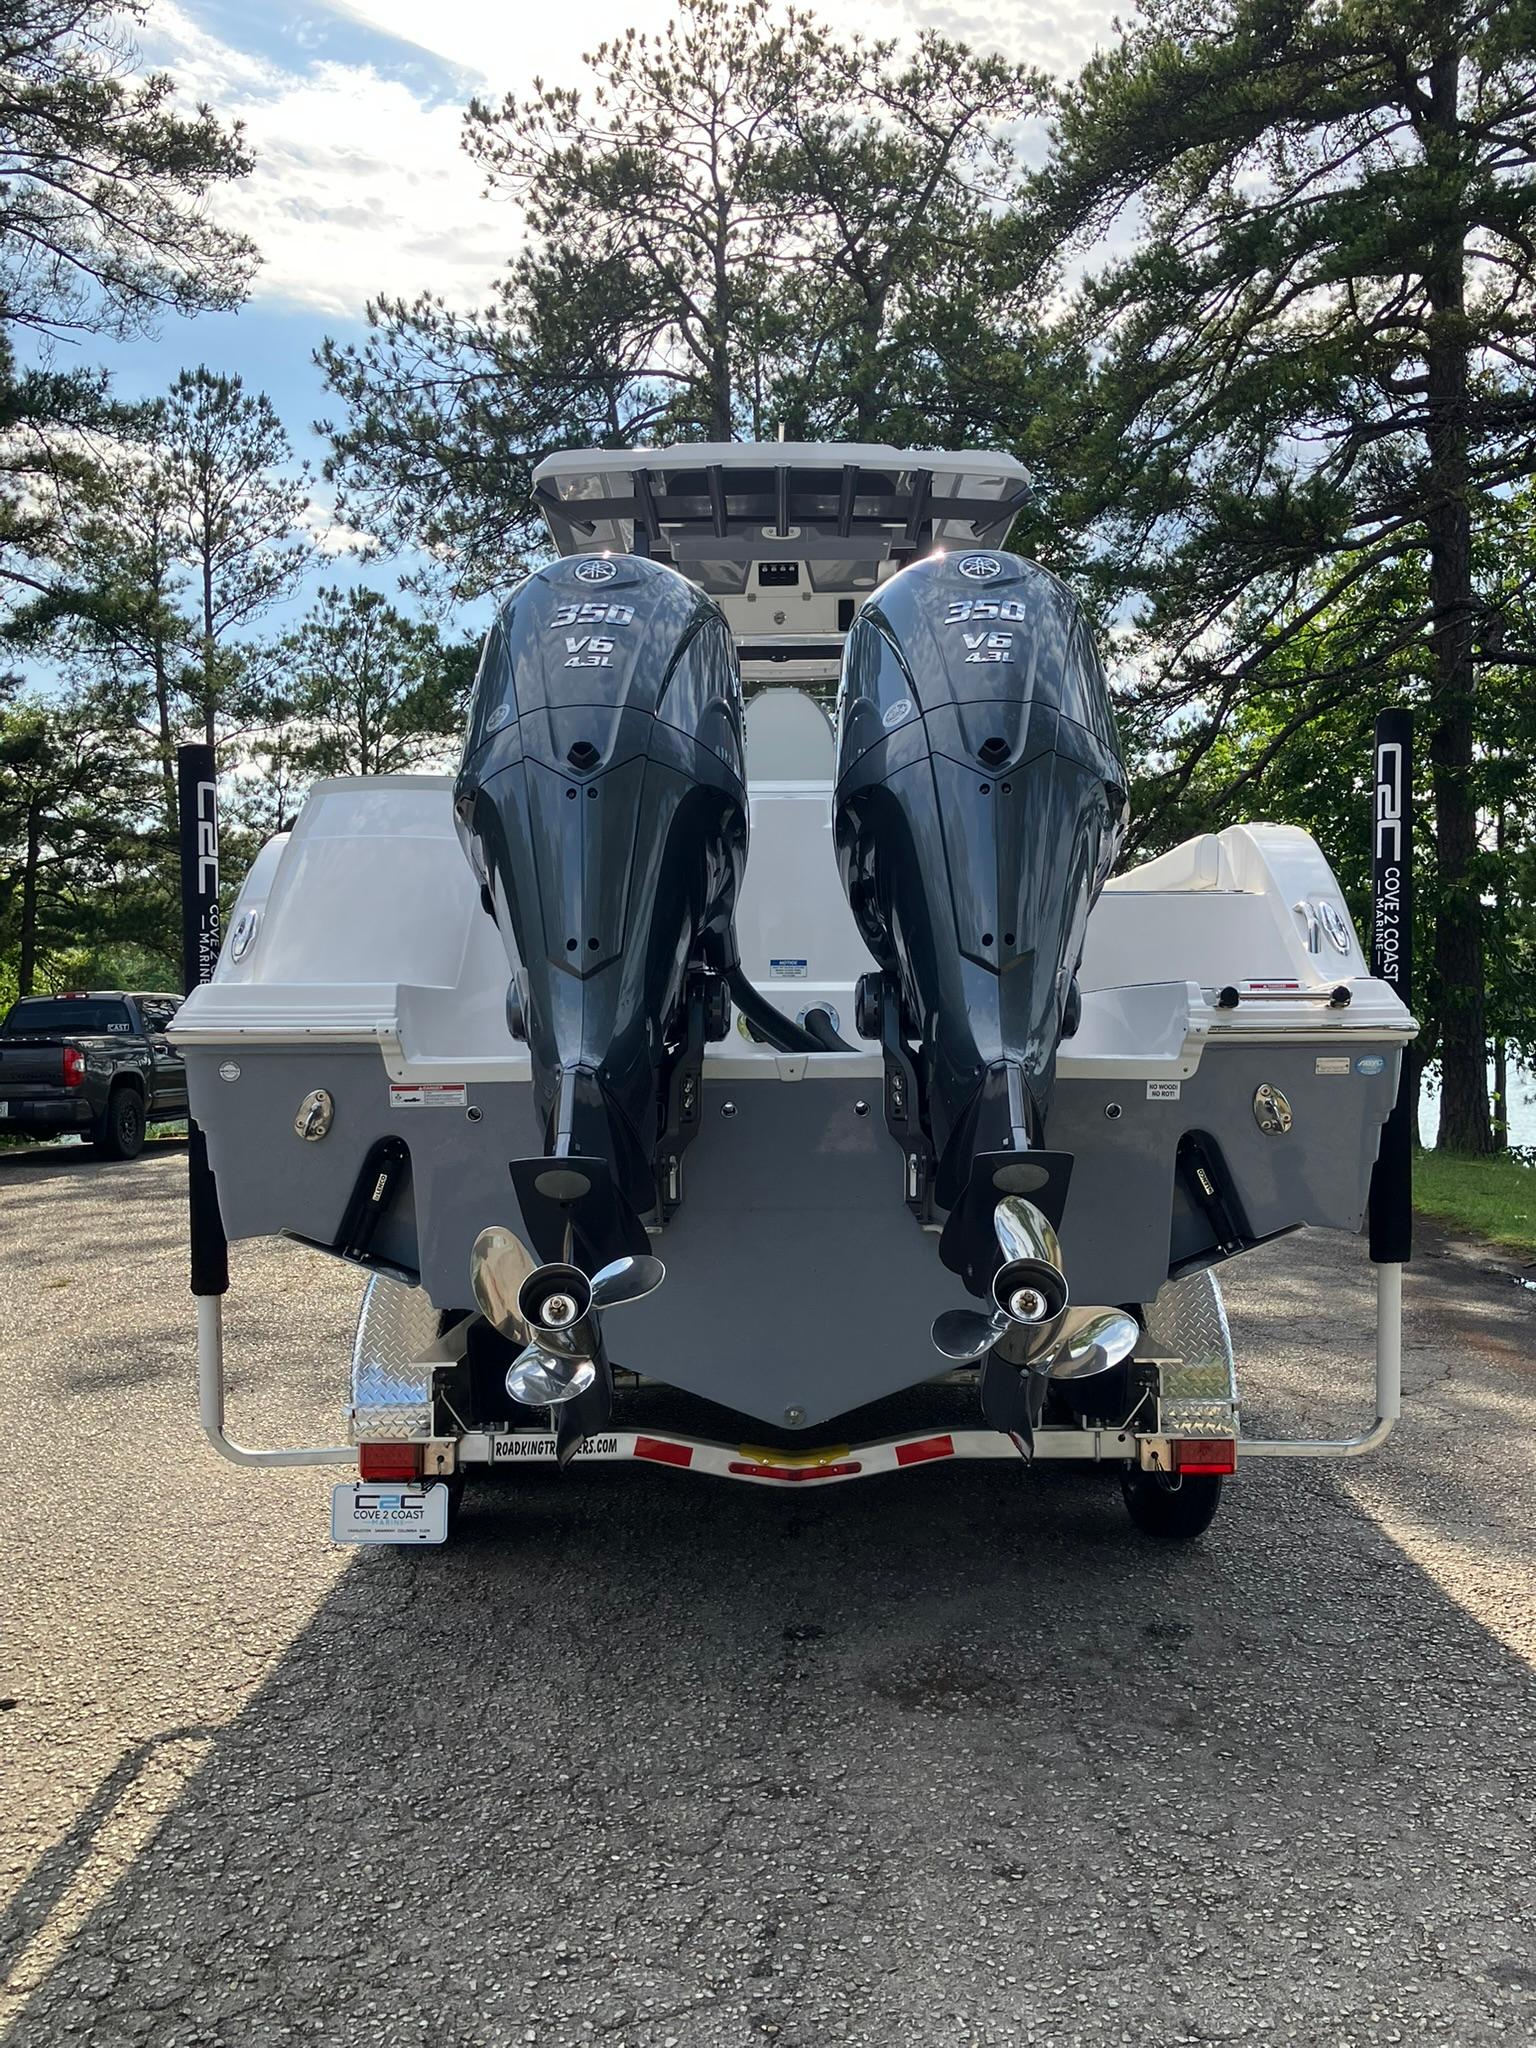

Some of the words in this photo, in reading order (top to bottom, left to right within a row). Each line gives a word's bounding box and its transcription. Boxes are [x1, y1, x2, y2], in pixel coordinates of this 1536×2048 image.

[550, 603, 635, 629] 350
[944, 600, 1026, 625] 350
[565, 636, 616, 654] V6
[962, 632, 1013, 650] V6
[564, 656, 614, 668] 4.3L
[965, 652, 1015, 664] 4.3L
[1384, 867, 1401, 911] COVE
[209, 904, 220, 946] COVE
[1375, 898, 1385, 950] MARINE
[1384, 915, 1400, 924] 2
[199, 933, 211, 984] MARINE
[1383, 928, 1400, 982] COAST
[355, 1494, 426, 1509] C2C
[353, 1510, 380, 1519] COVE
[382, 1510, 389, 1519] 2
[391, 1510, 425, 1519] COAST
